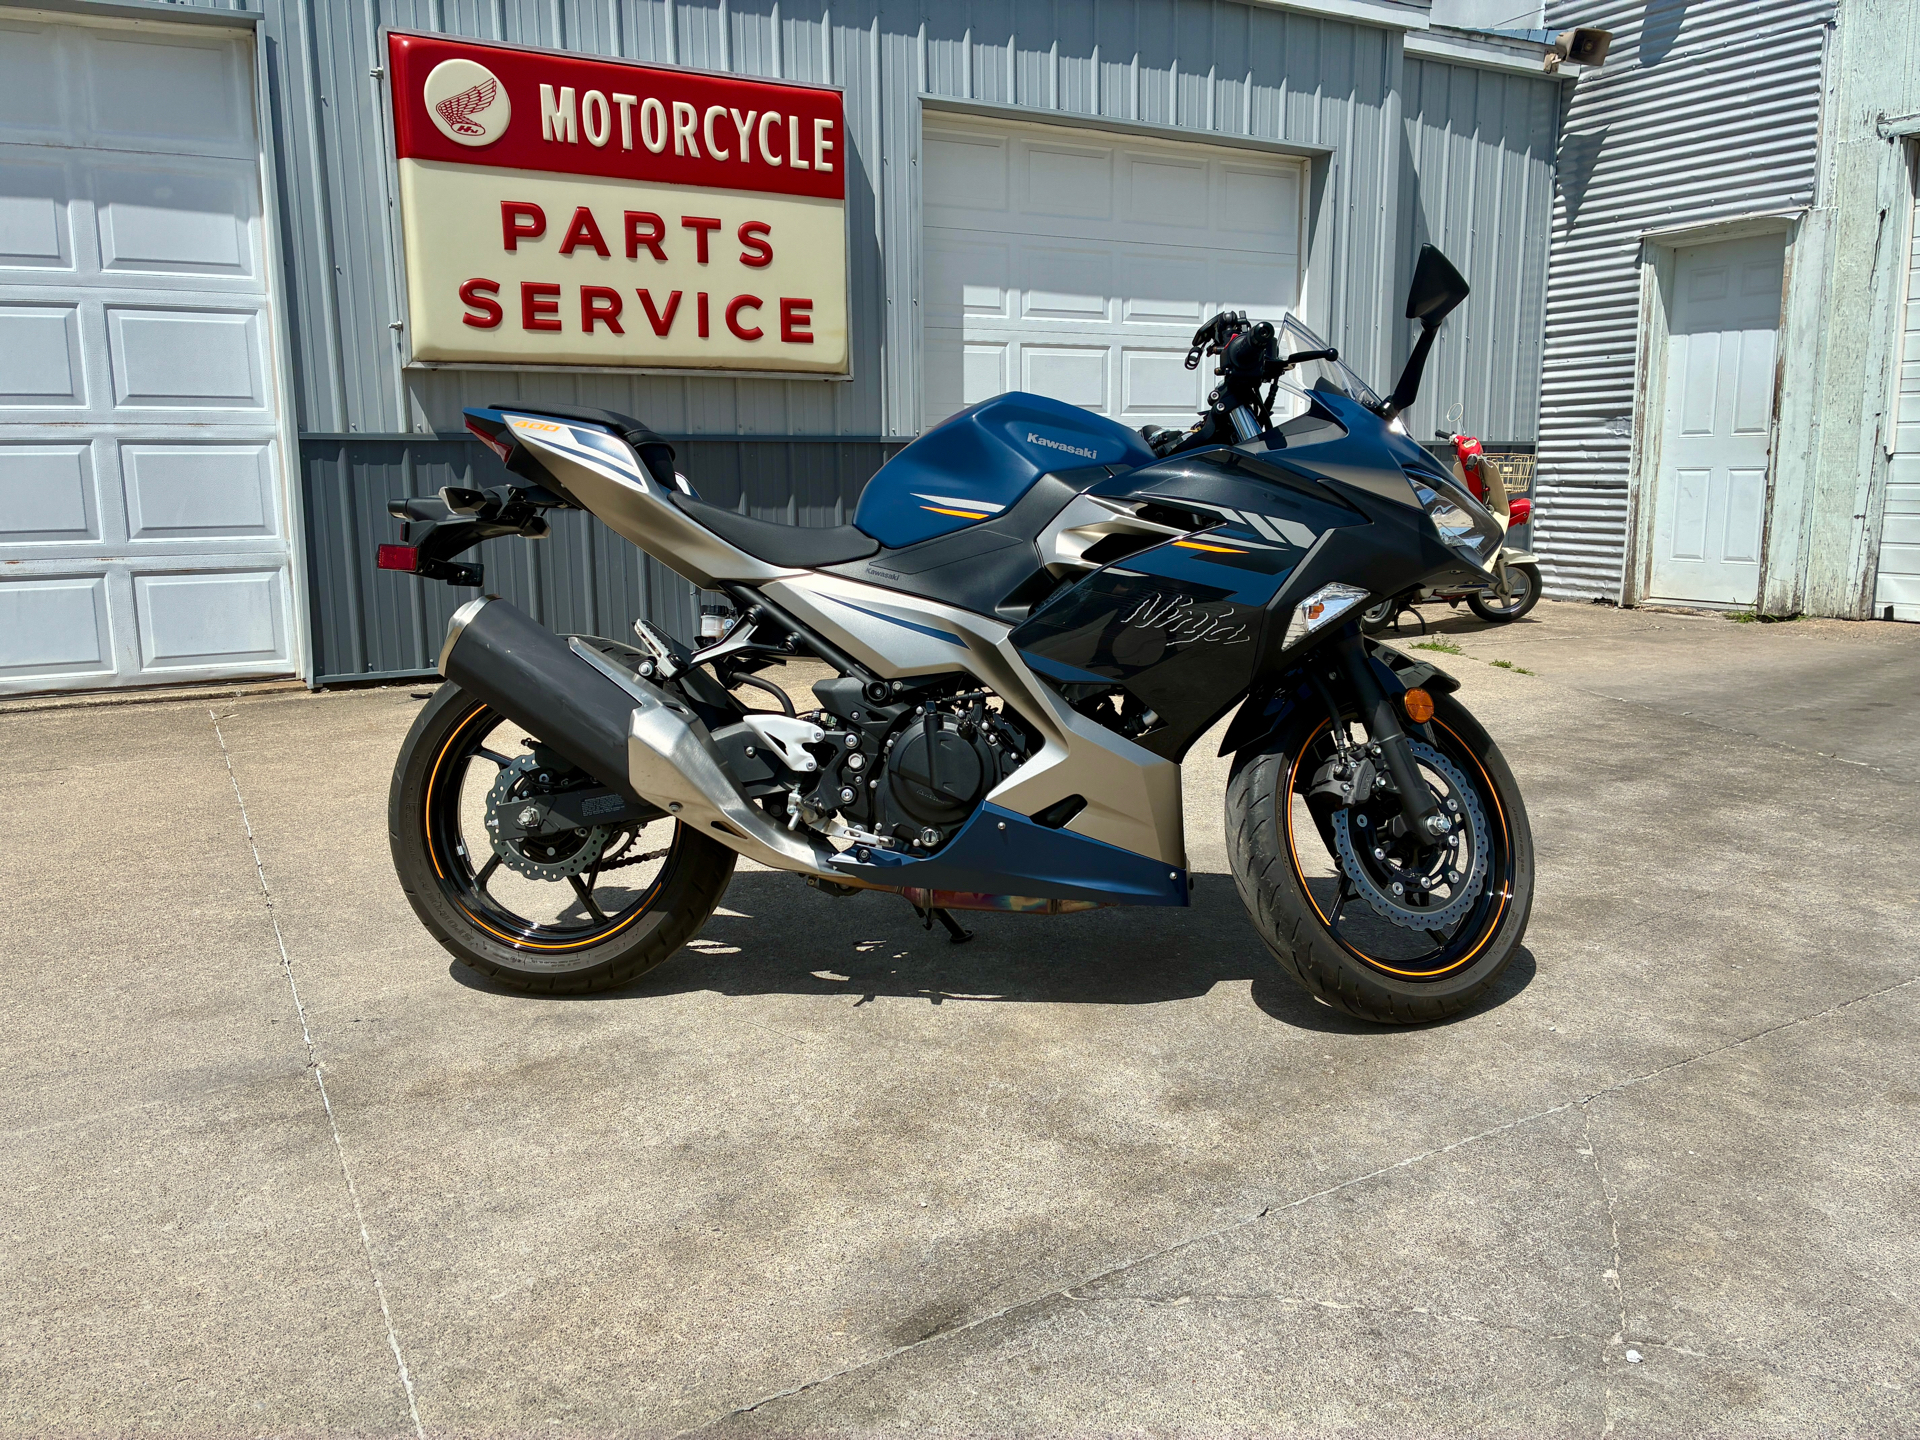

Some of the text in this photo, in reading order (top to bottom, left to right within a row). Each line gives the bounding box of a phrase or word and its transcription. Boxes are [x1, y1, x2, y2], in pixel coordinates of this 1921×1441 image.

[539, 83, 834, 172] MOTORCYCLE
[500, 200, 774, 268] PARTS
[459, 278, 814, 344] SERVICE
[514, 421, 560, 432] 400
[1027, 432, 1098, 460] Kawasaki
[866, 568, 899, 581] Kawasaki
[1120, 592, 1250, 647] Ninja
